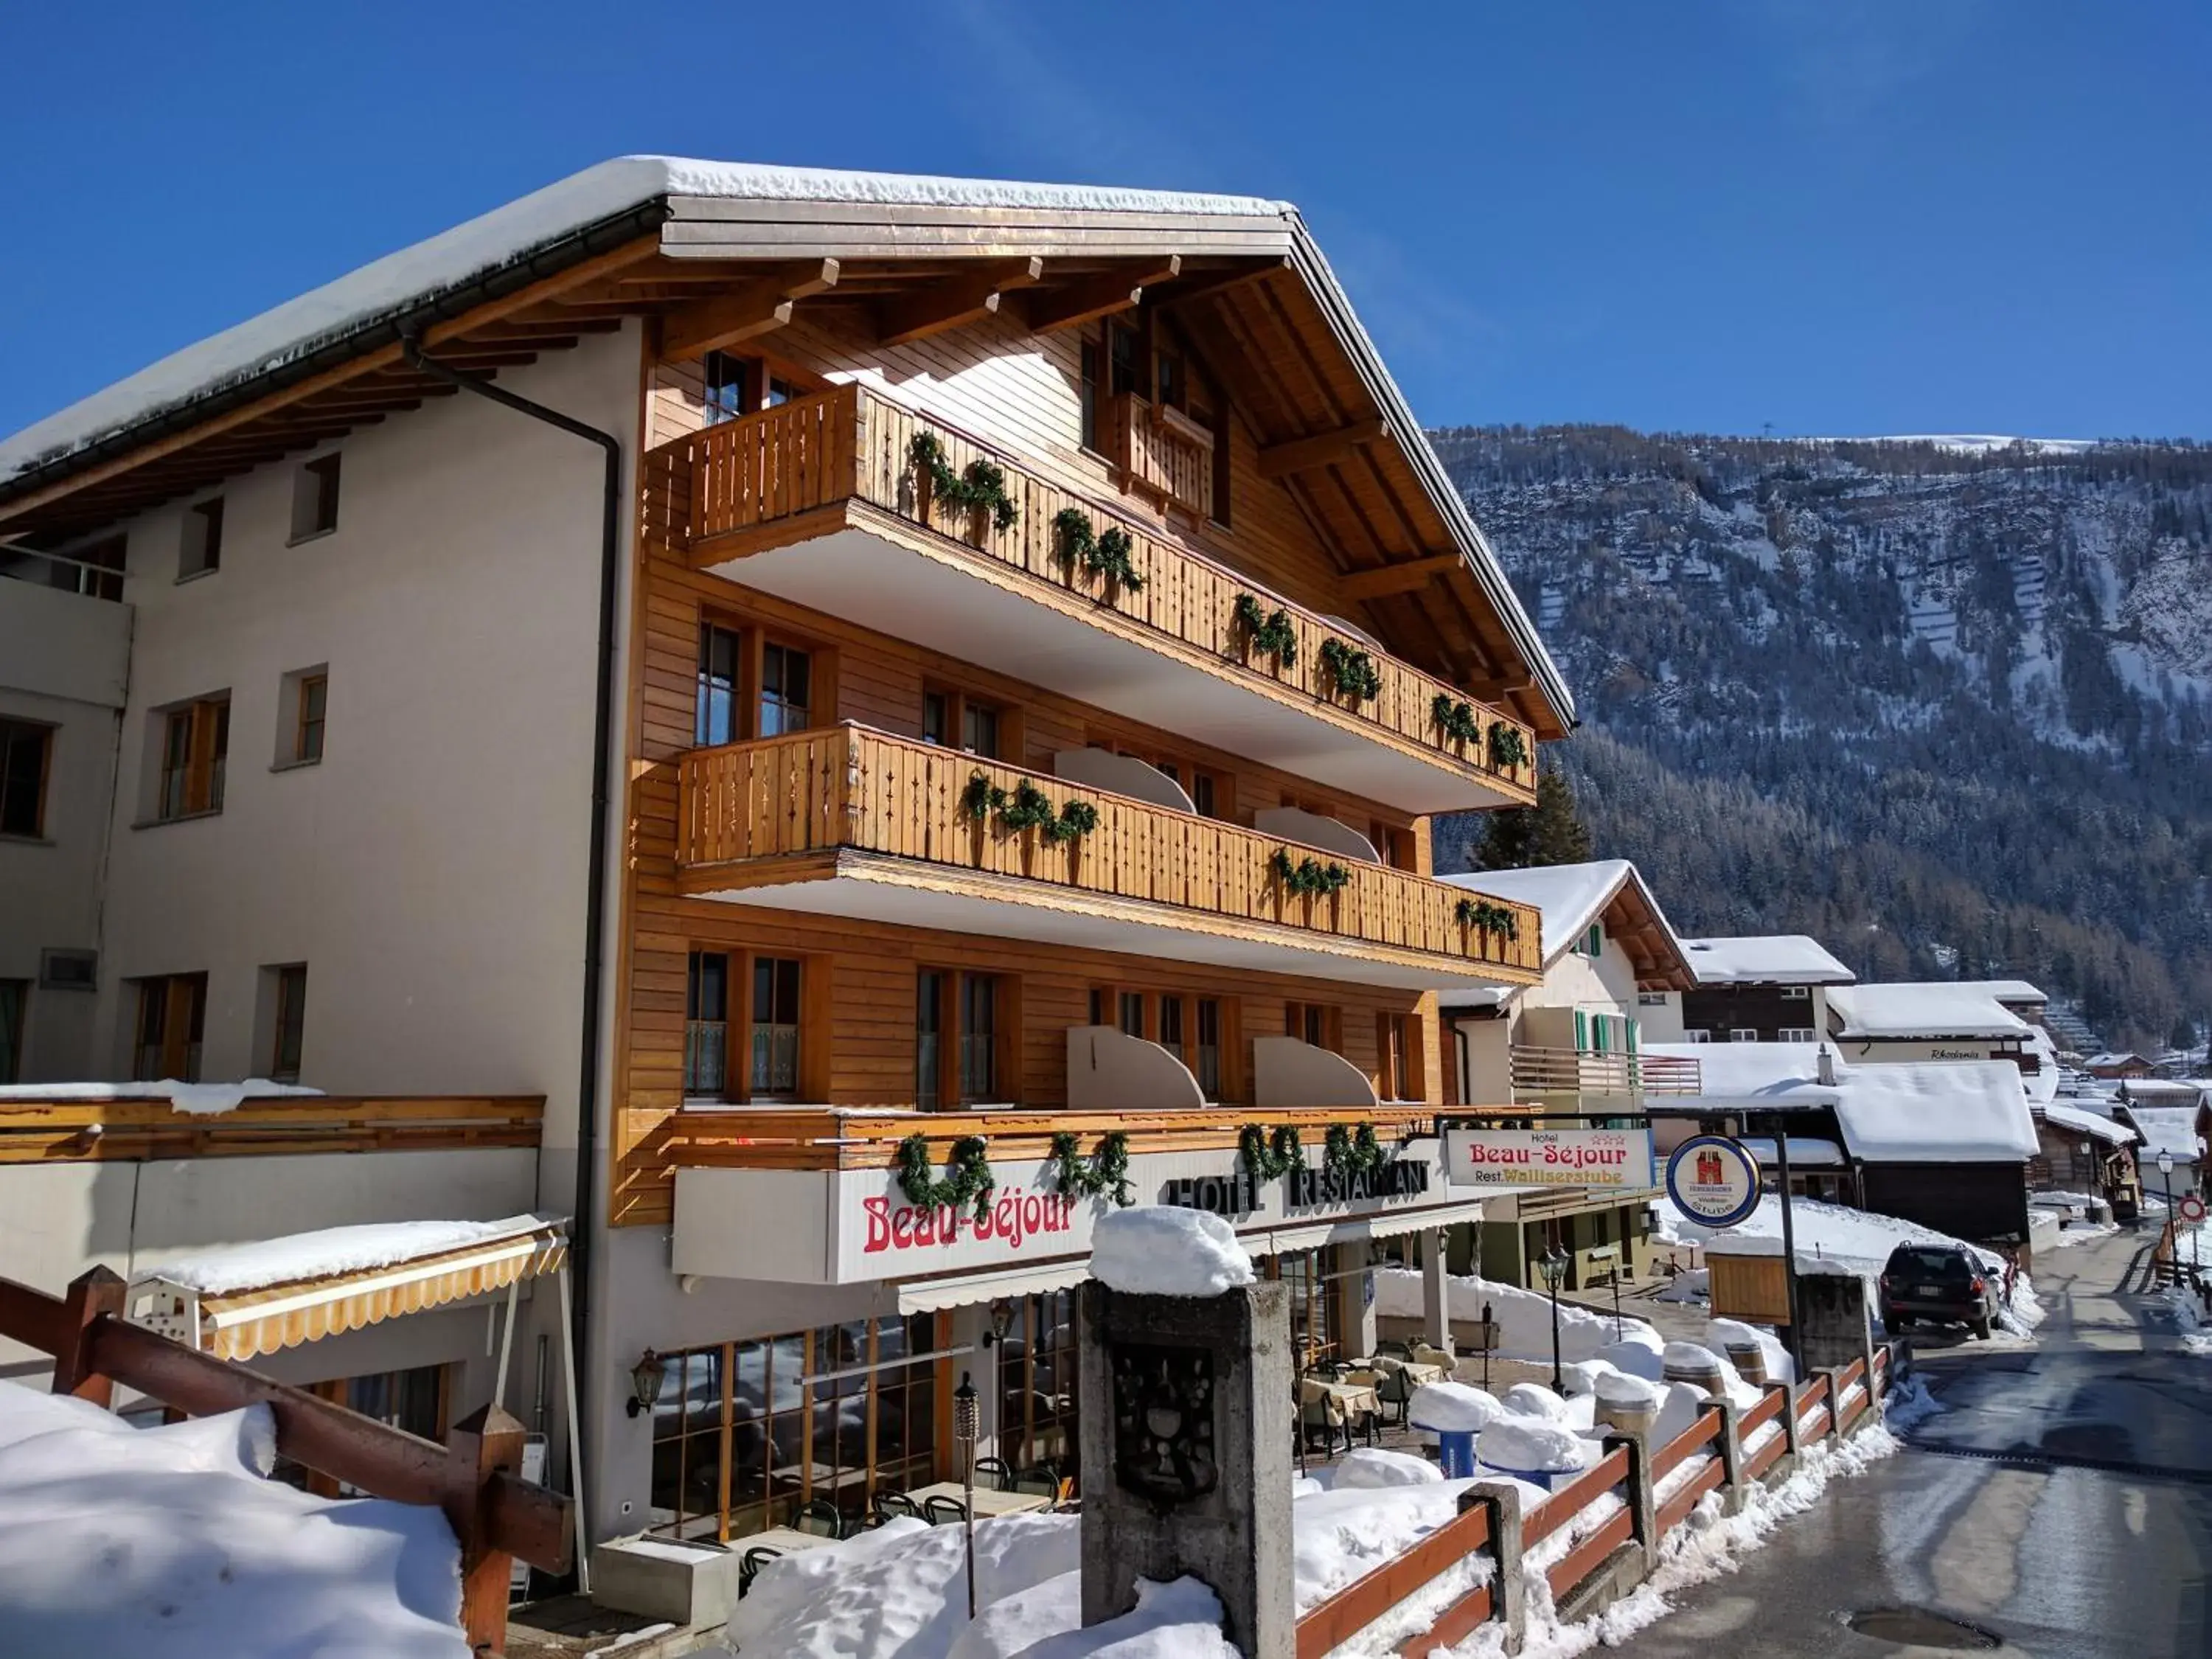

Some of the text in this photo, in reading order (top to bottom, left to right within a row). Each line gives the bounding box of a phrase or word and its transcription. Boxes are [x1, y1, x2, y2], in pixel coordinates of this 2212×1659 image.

[1531, 1133, 1558, 1144] Hotel
[1470, 1144, 1627, 1169] Beau-Séjour
[1178, 1172, 1265, 1214] HOTEL
